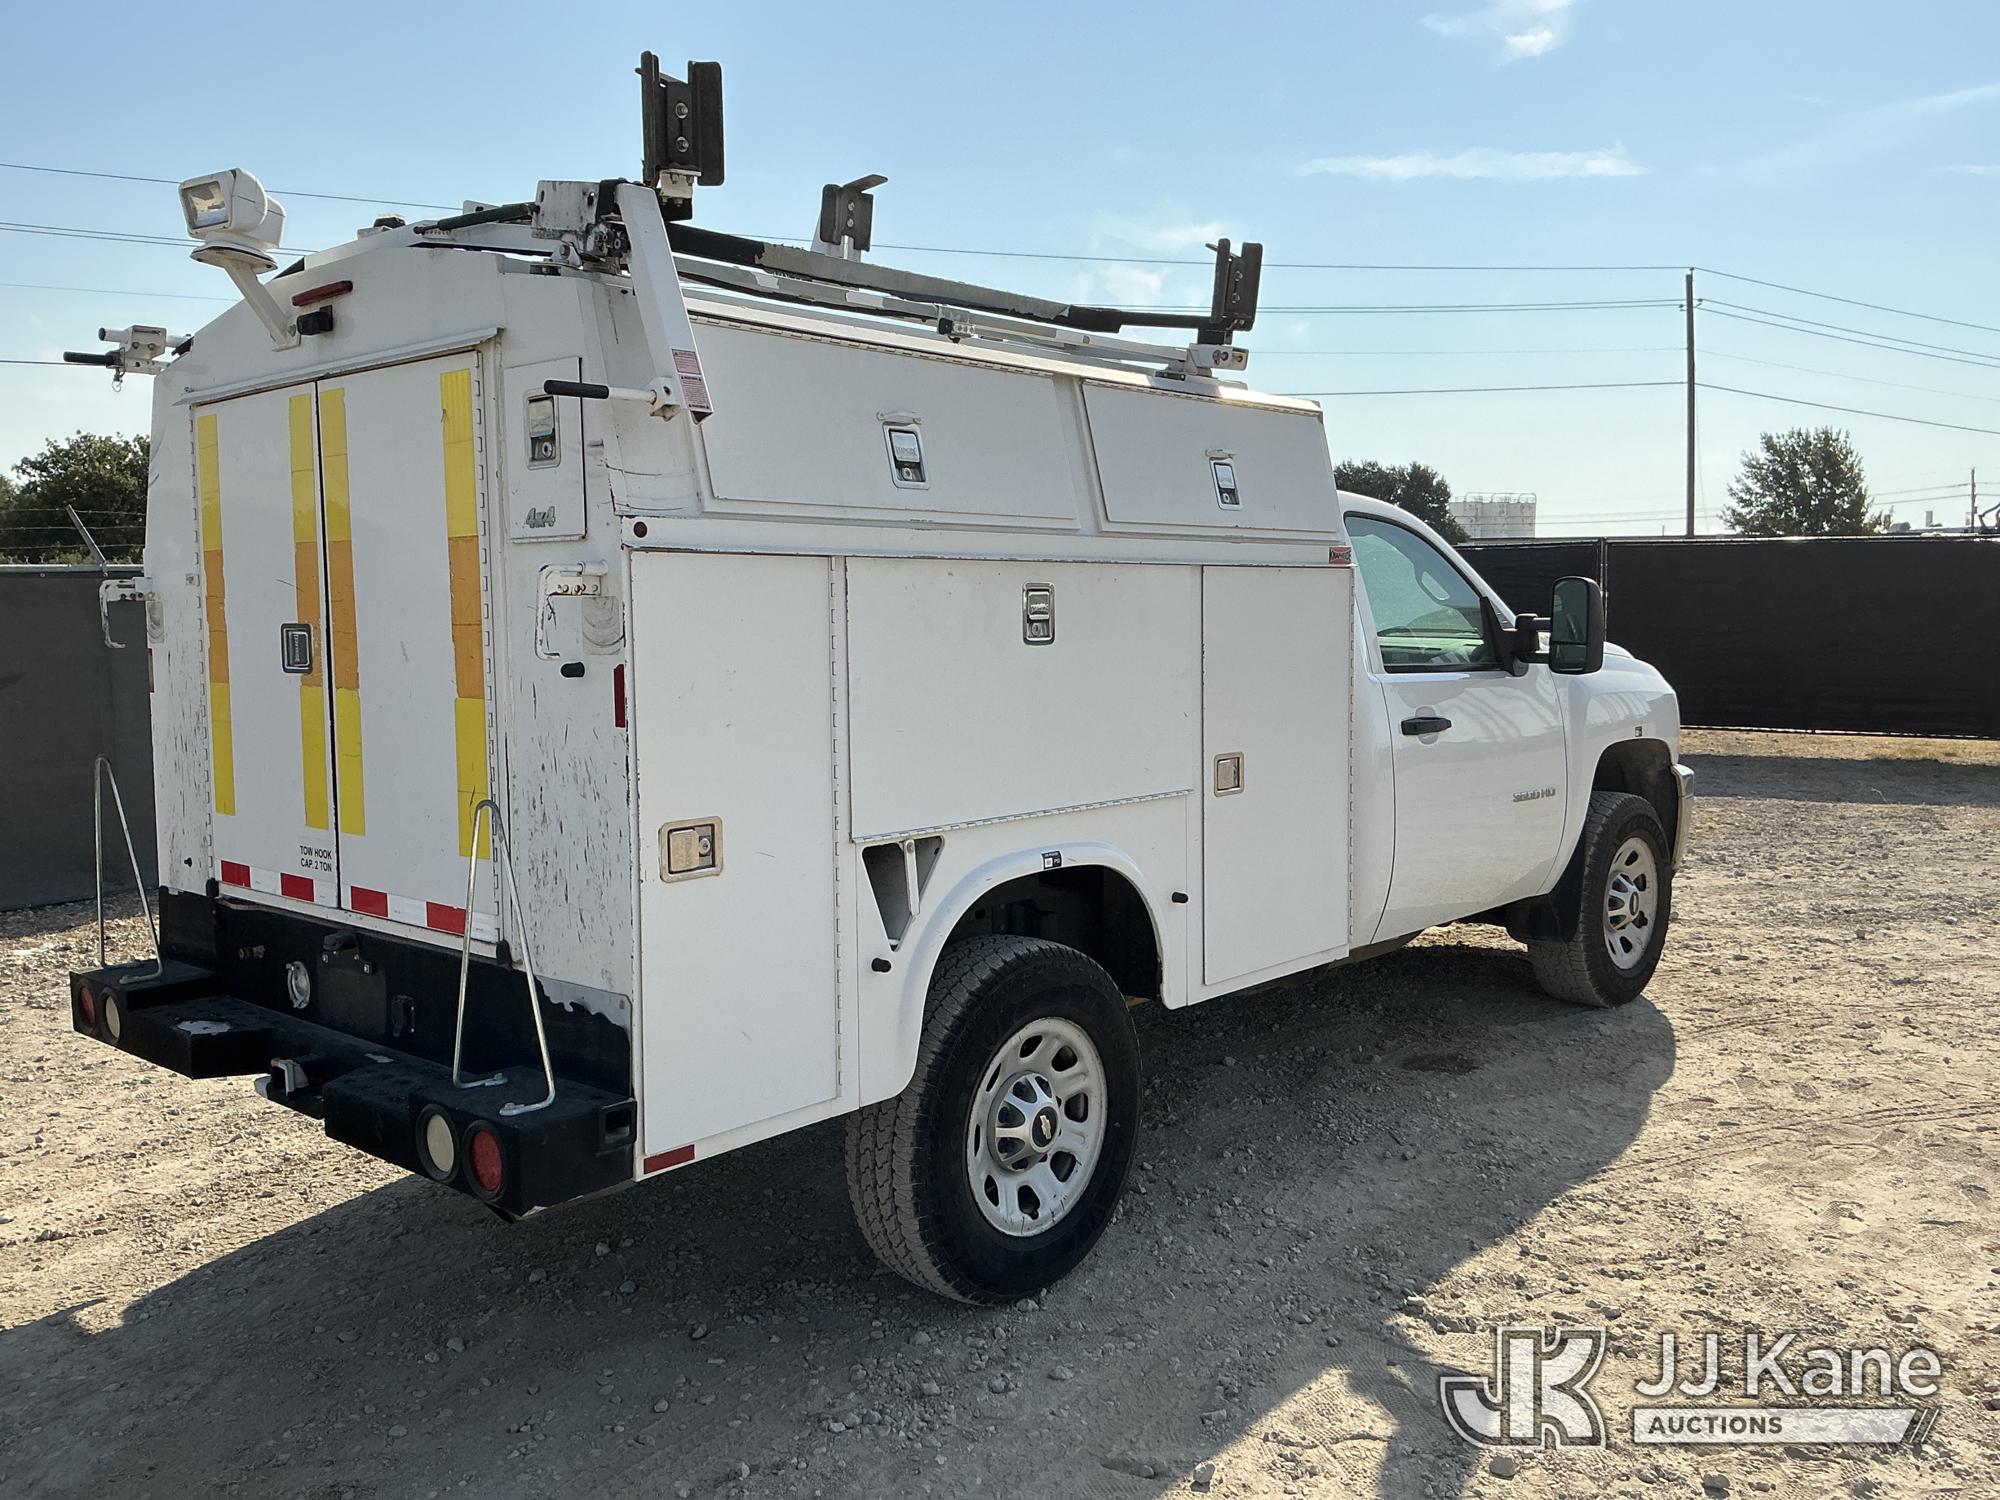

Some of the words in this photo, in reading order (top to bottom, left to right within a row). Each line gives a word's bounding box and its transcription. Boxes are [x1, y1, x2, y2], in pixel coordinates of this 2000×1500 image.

[300, 845, 313, 856] TOW
[314, 848, 332, 859] HOOK
[315, 860, 319, 870] 2
[320, 861, 332, 872] TON
